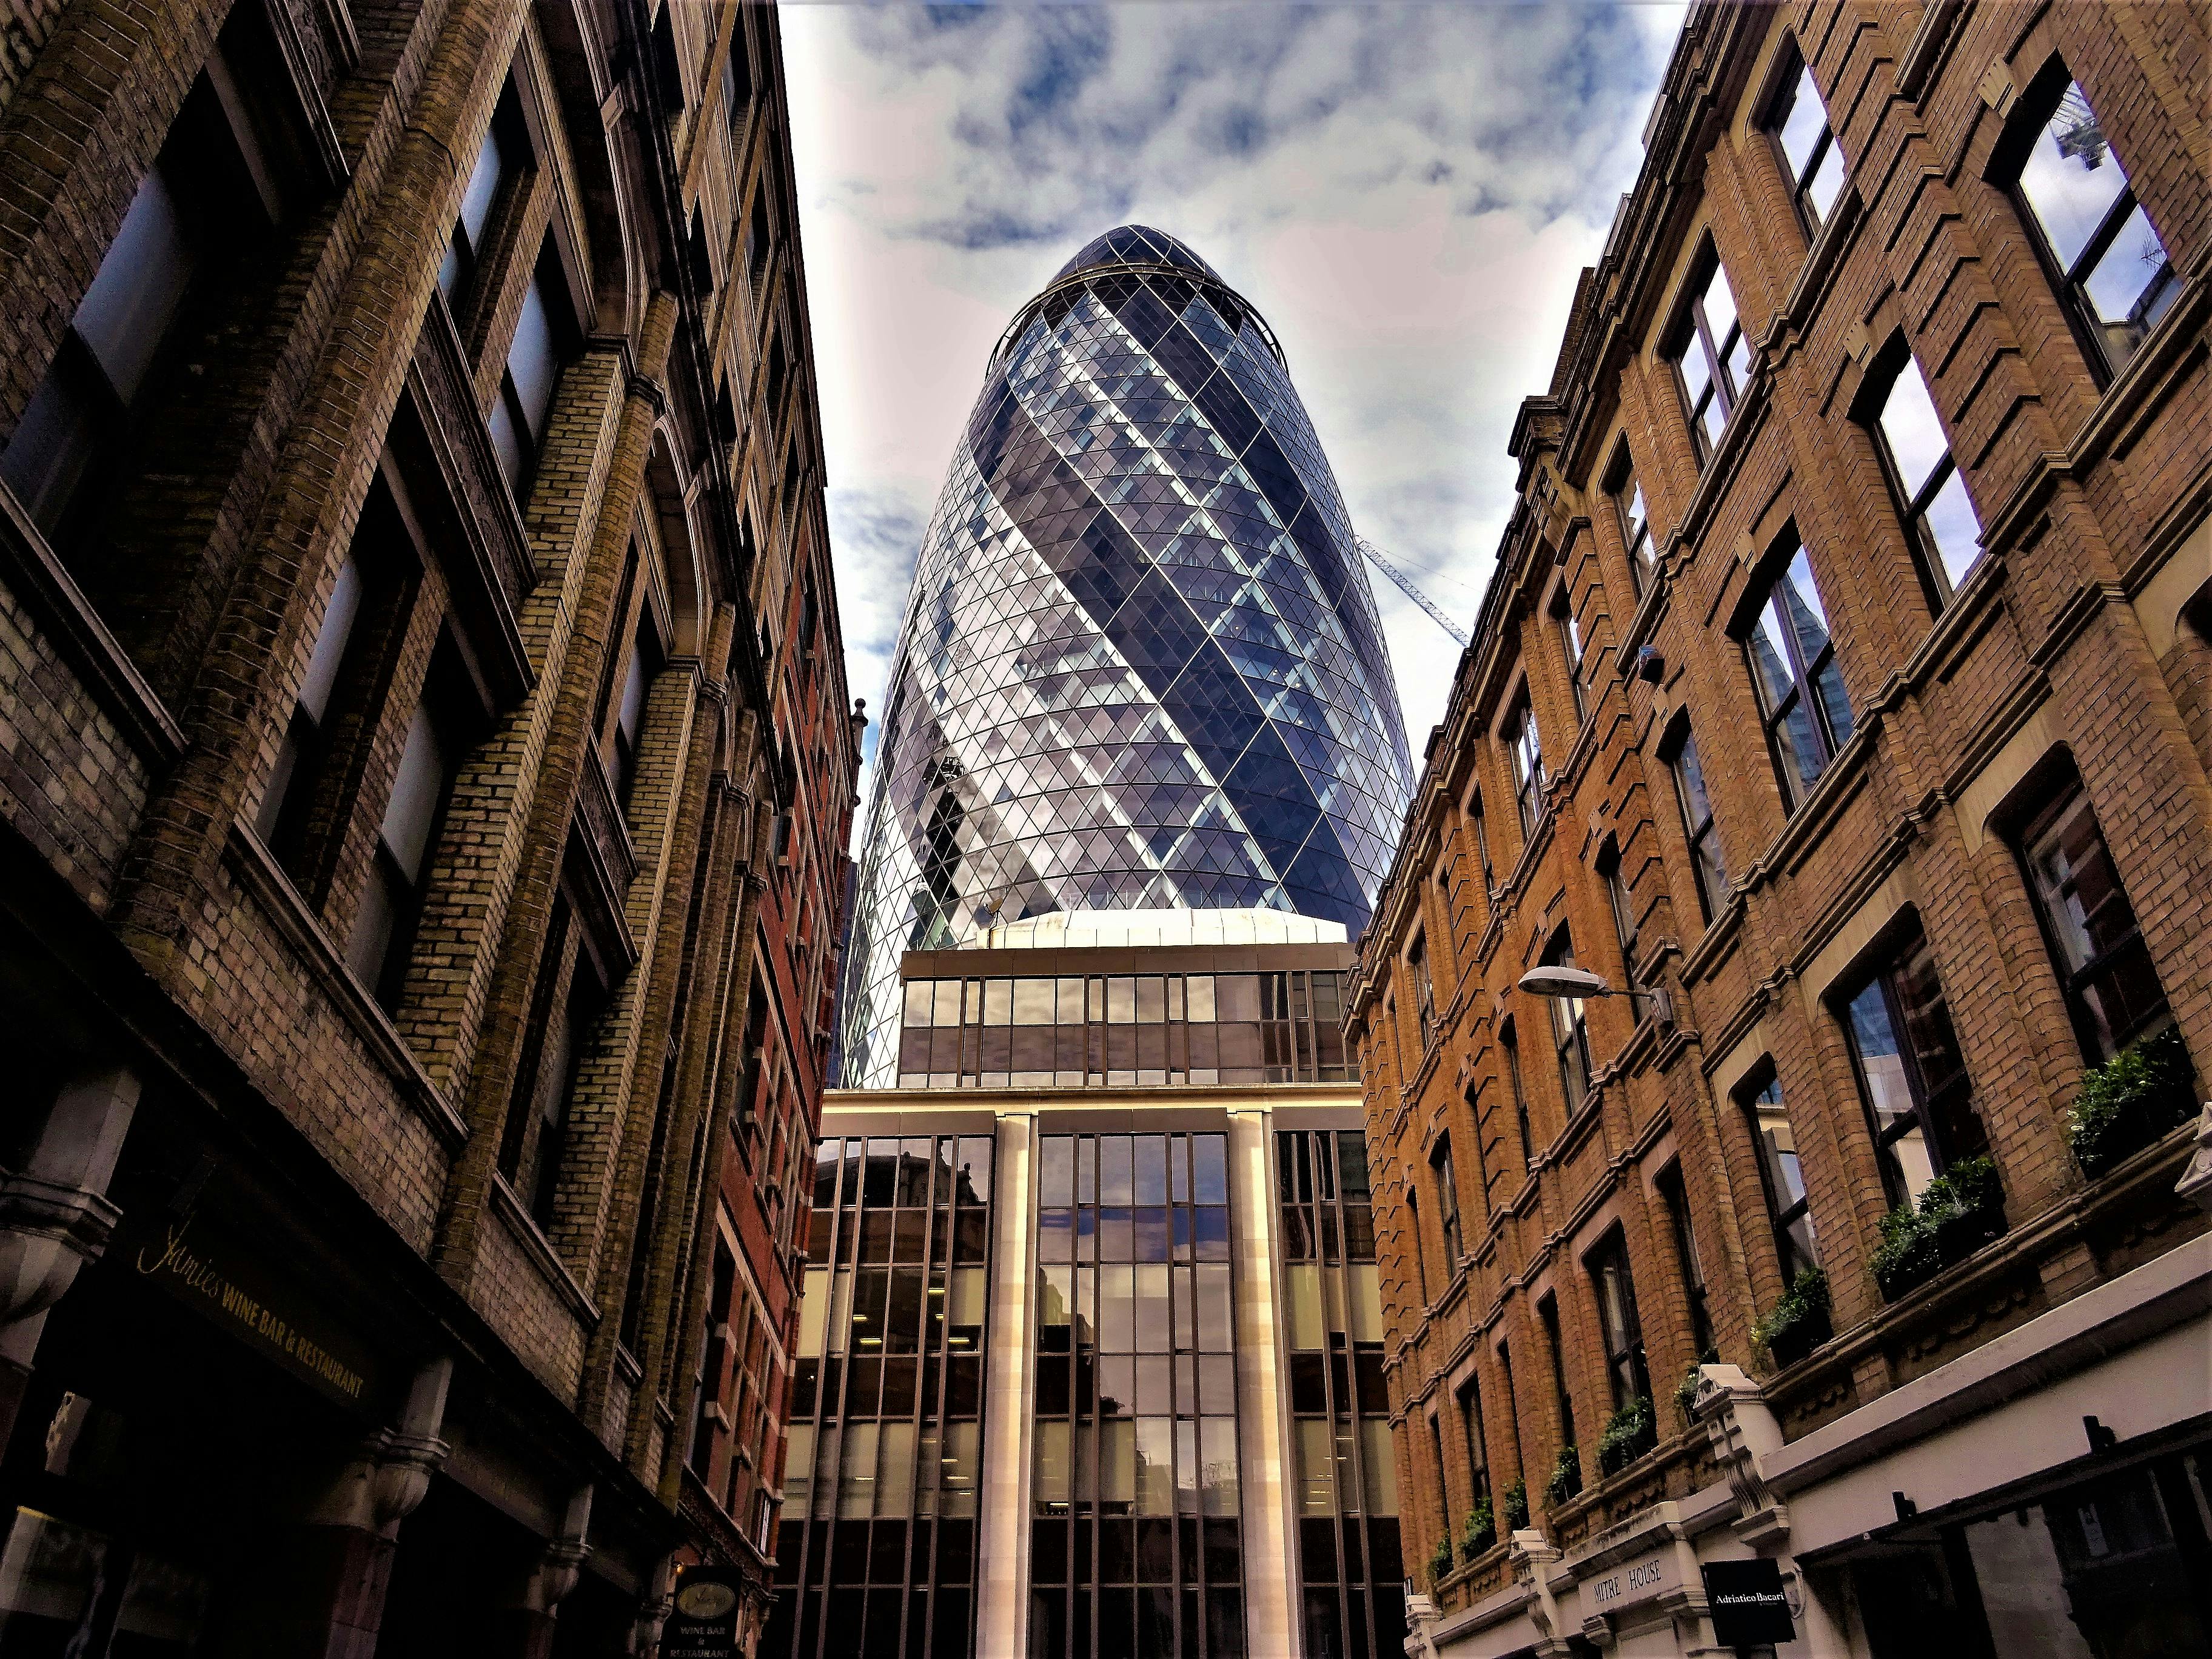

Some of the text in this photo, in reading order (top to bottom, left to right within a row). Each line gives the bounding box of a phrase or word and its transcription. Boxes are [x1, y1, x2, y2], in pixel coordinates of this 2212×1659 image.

[222, 1282, 260, 1327] WINE
[258, 1309, 286, 1346] BAR
[285, 1329, 297, 1353] &
[296, 1336, 364, 1398] RESTAURANT
[1594, 1559, 1662, 1603] MITRE HOUSE
[1716, 1594, 1756, 1604] Adriatico
[1755, 1592, 1785, 1602] Bacari
[680, 1626, 726, 1635] WINE BAR
[669, 1649, 730, 1658] RESTAURANT
